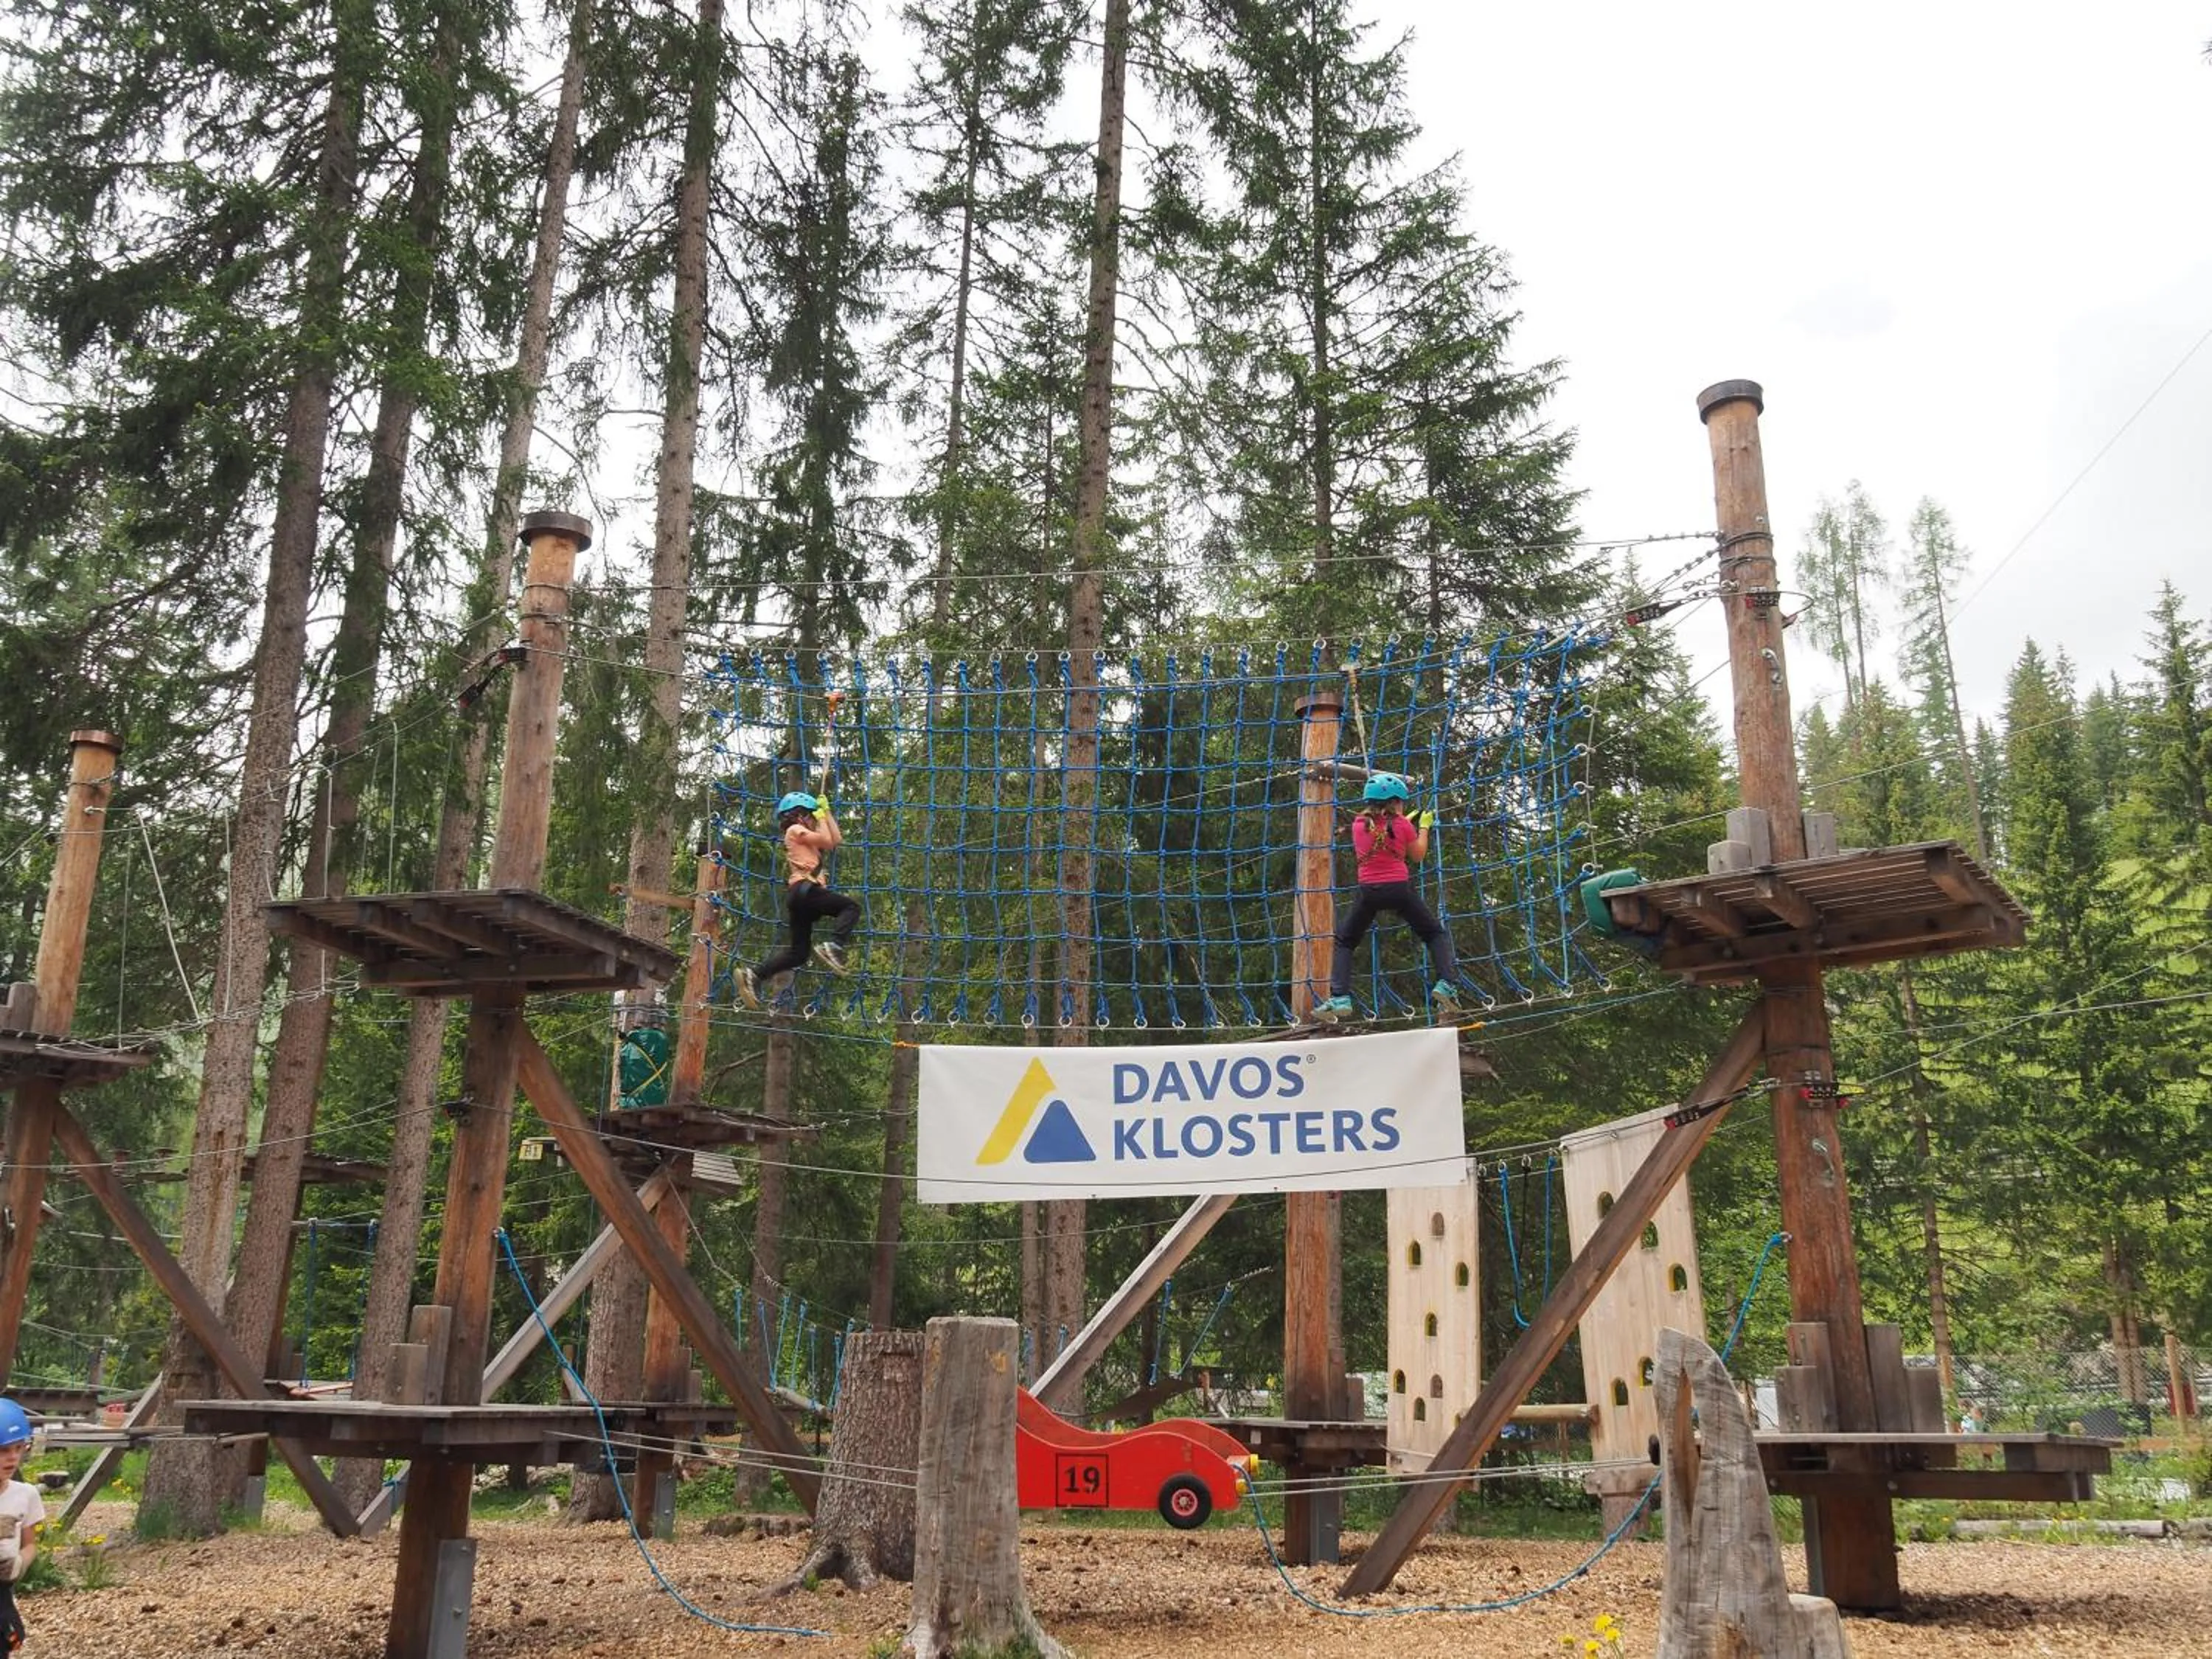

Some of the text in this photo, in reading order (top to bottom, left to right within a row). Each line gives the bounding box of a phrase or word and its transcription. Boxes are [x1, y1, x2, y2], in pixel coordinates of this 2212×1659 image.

[1113, 1054, 1304, 1105] DAVOS
[1113, 1107, 1401, 1161] KLOSTERS
[1064, 1464, 1100, 1494] 19
